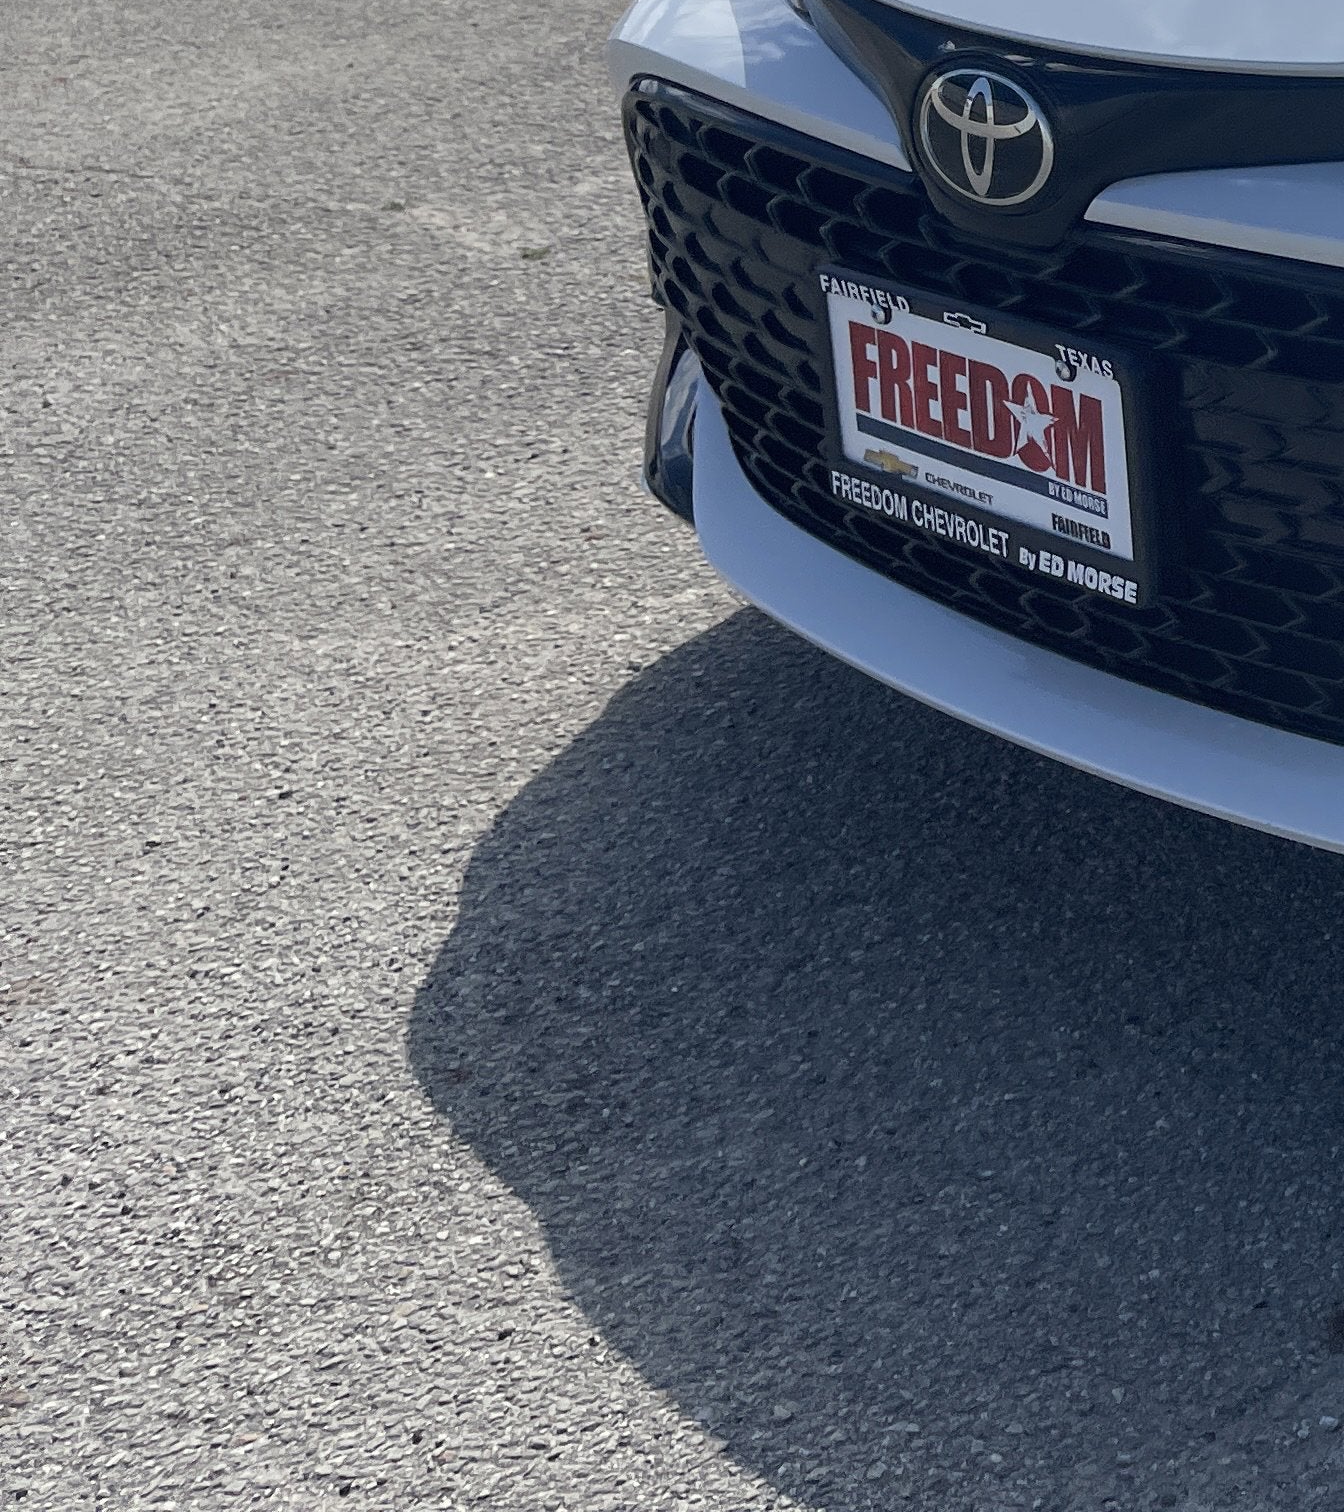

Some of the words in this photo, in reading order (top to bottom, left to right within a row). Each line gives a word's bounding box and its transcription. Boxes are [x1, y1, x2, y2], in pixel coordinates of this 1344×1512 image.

[819, 274, 909, 313] FAIRFIELD
[1054, 344, 1114, 380] TEXAS
[848, 321, 1106, 495] FREEDOM
[925, 472, 993, 506] CHEVROLET
[1048, 481, 1060, 498] BY
[1061, 486, 1073, 503] ED
[1074, 489, 1106, 515] MORSE
[831, 470, 908, 522] FREEDOM
[911, 500, 1009, 558] CHEVROLET
[1051, 513, 1111, 550] FAIRFIELD
[1039, 550, 1064, 578] ED
[1067, 559, 1138, 604] MORSE
